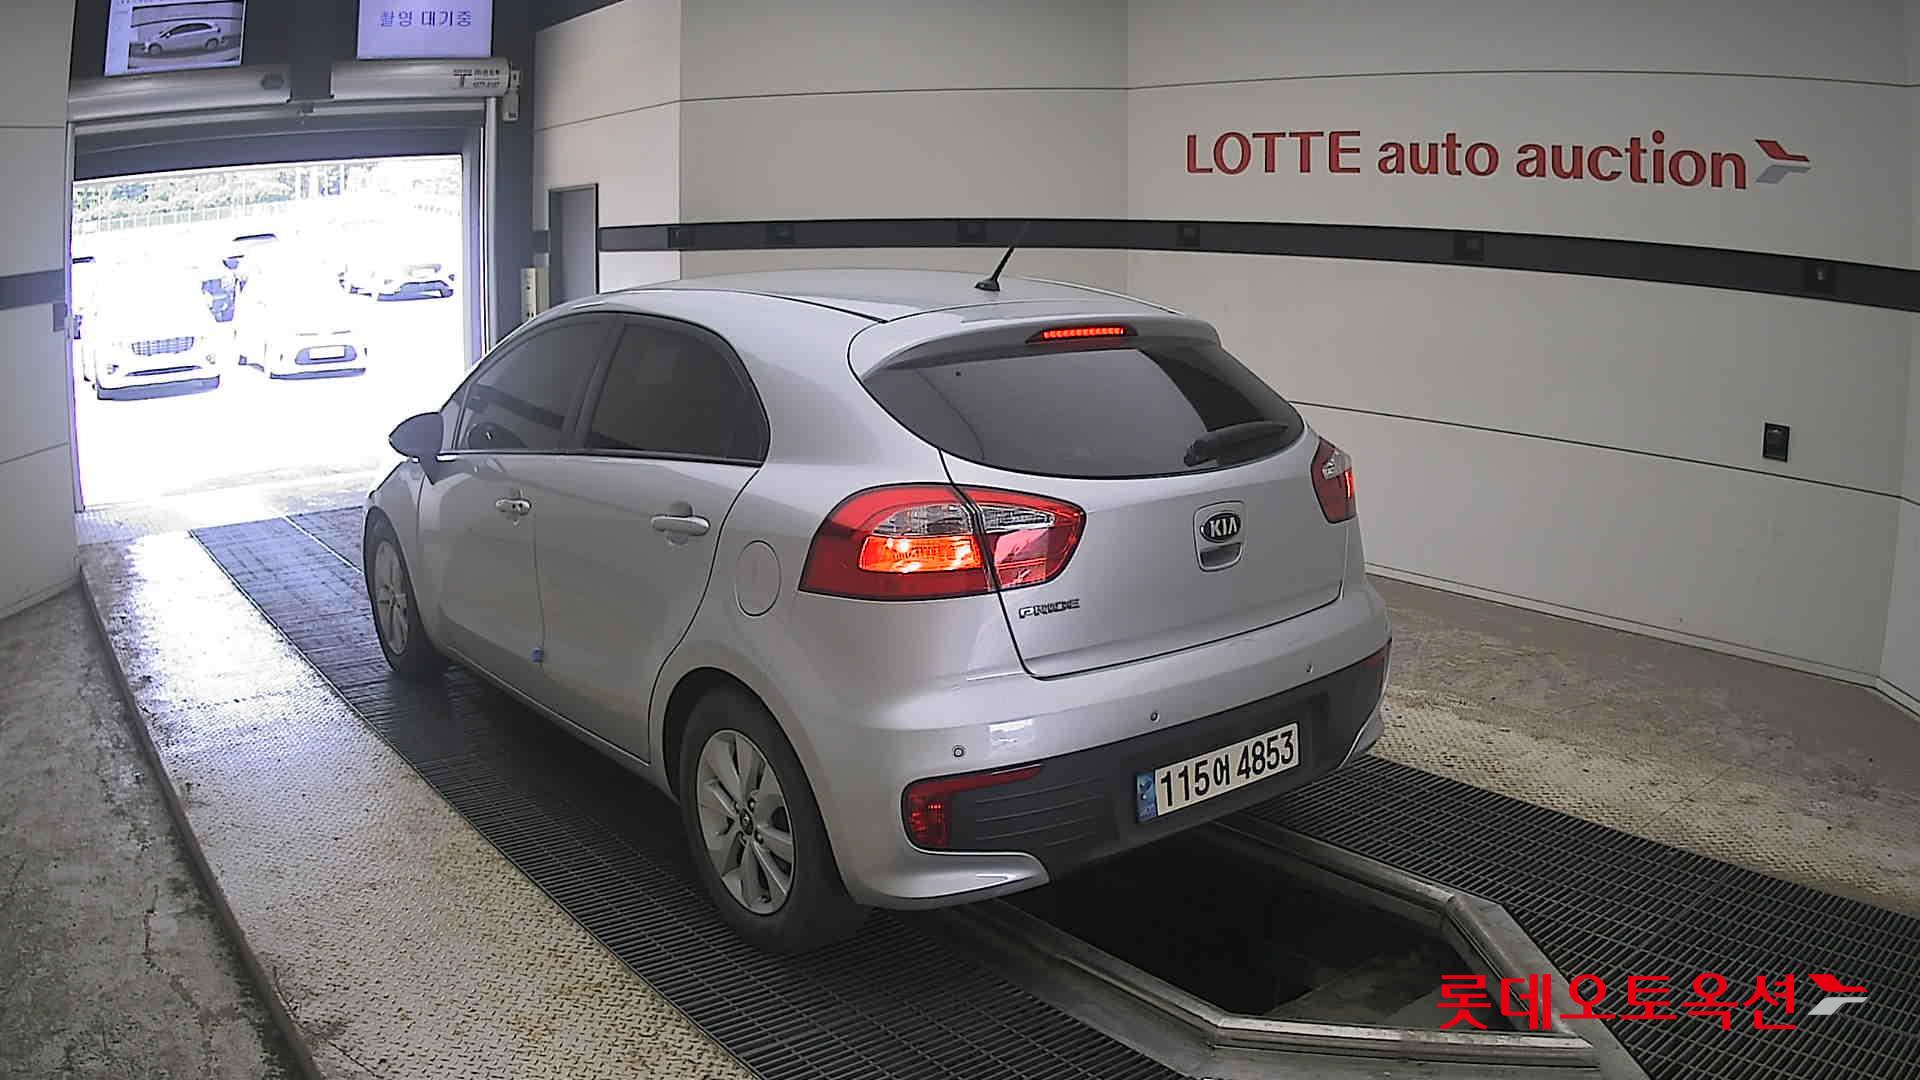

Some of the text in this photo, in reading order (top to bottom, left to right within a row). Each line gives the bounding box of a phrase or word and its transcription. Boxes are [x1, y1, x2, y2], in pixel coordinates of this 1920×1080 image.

[421, 10, 472, 27] 대기중
[1186, 129, 1748, 190] LOTTE auto auction
[1210, 516, 1238, 538] KIA
[1160, 730, 1294, 807] 115어 4853
